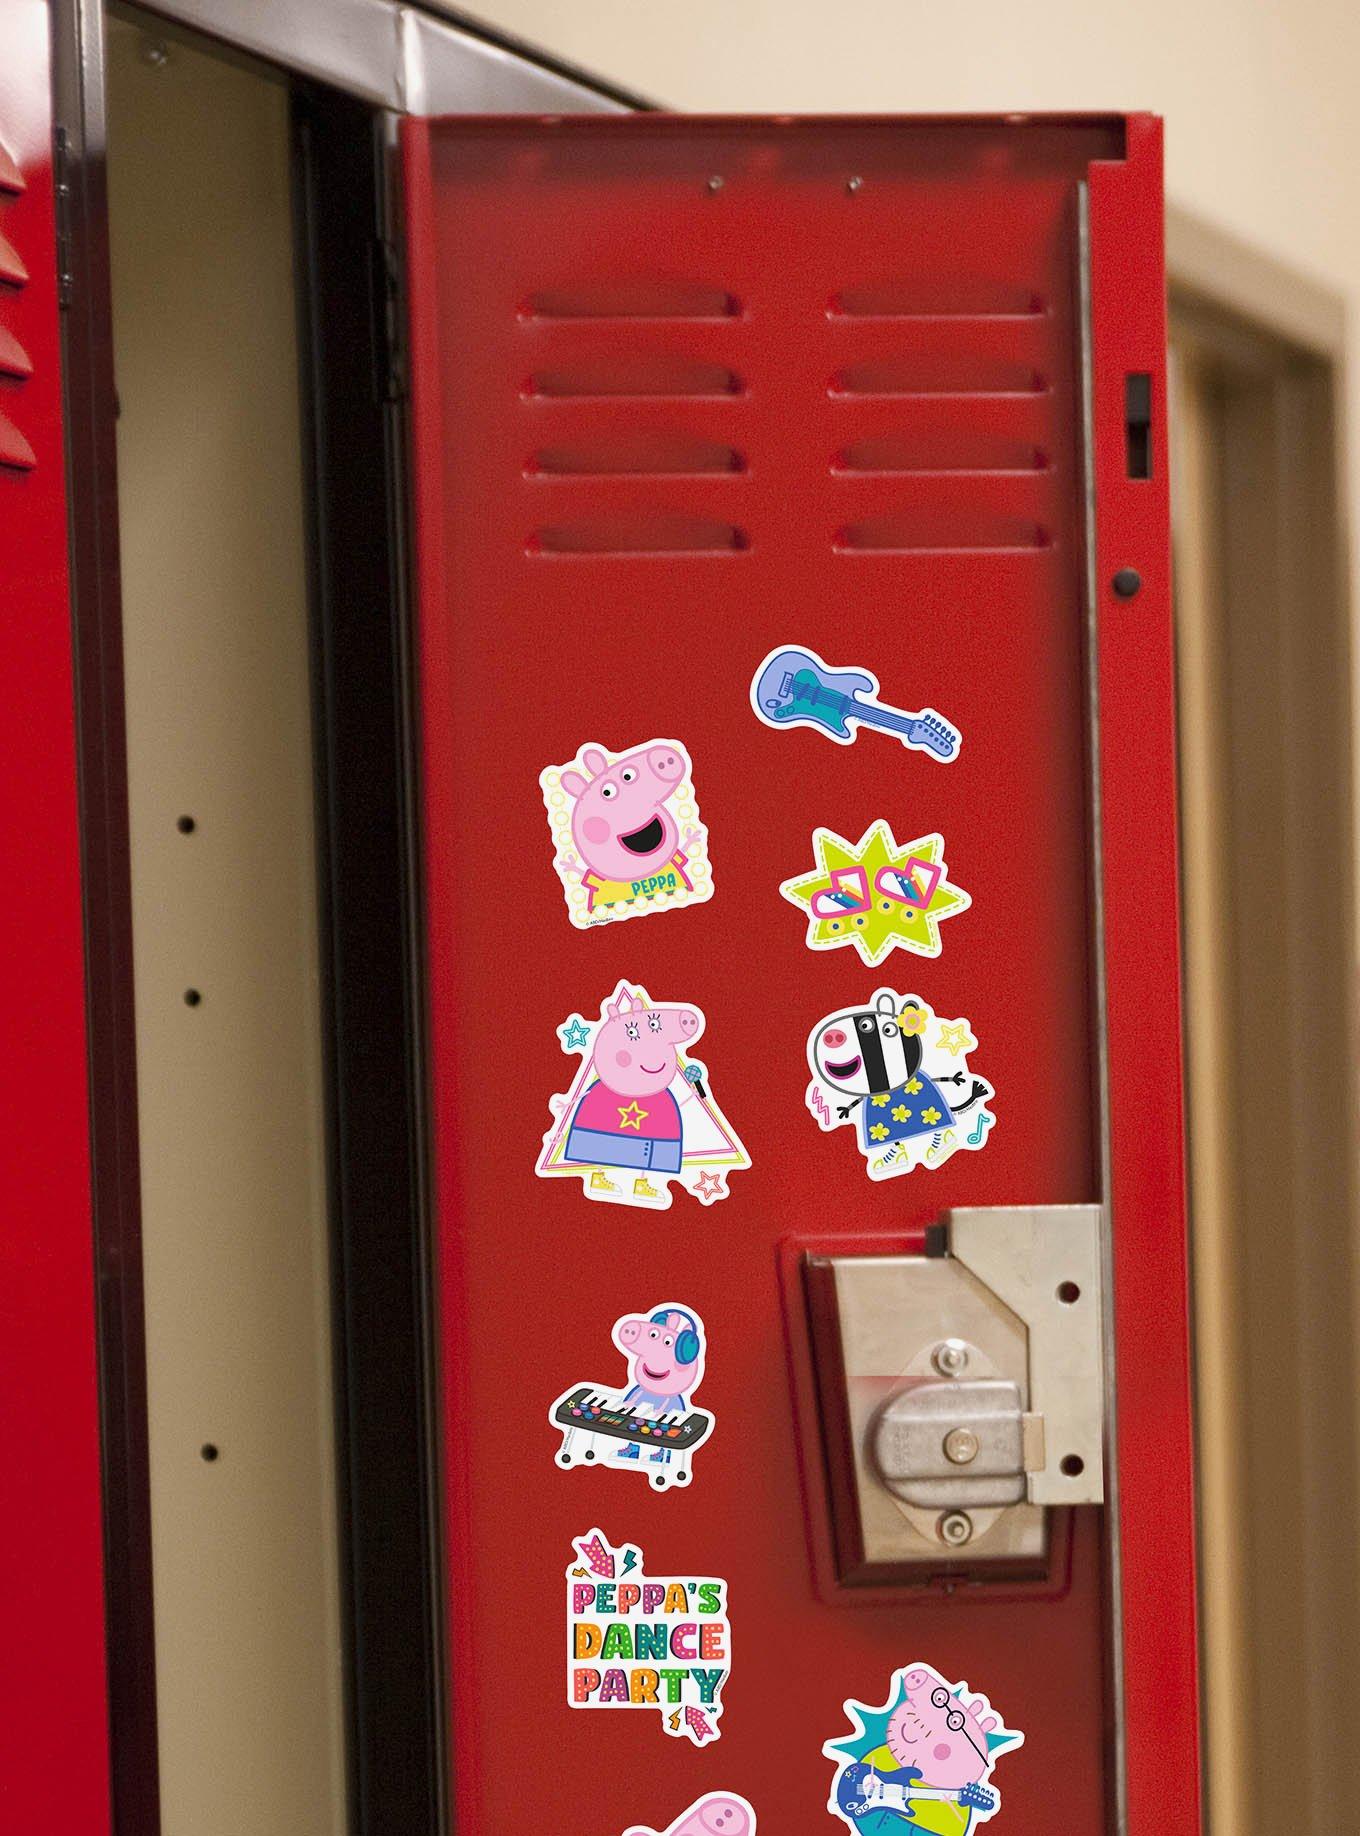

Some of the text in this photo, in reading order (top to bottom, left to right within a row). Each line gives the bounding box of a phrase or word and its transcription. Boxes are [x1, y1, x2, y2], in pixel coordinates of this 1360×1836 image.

[631, 873, 676, 896] PEPPA
[573, 1583, 721, 1614] PEPPA'S
[573, 1623, 725, 1660] DANCE
[573, 1668, 724, 1703] PARTY
